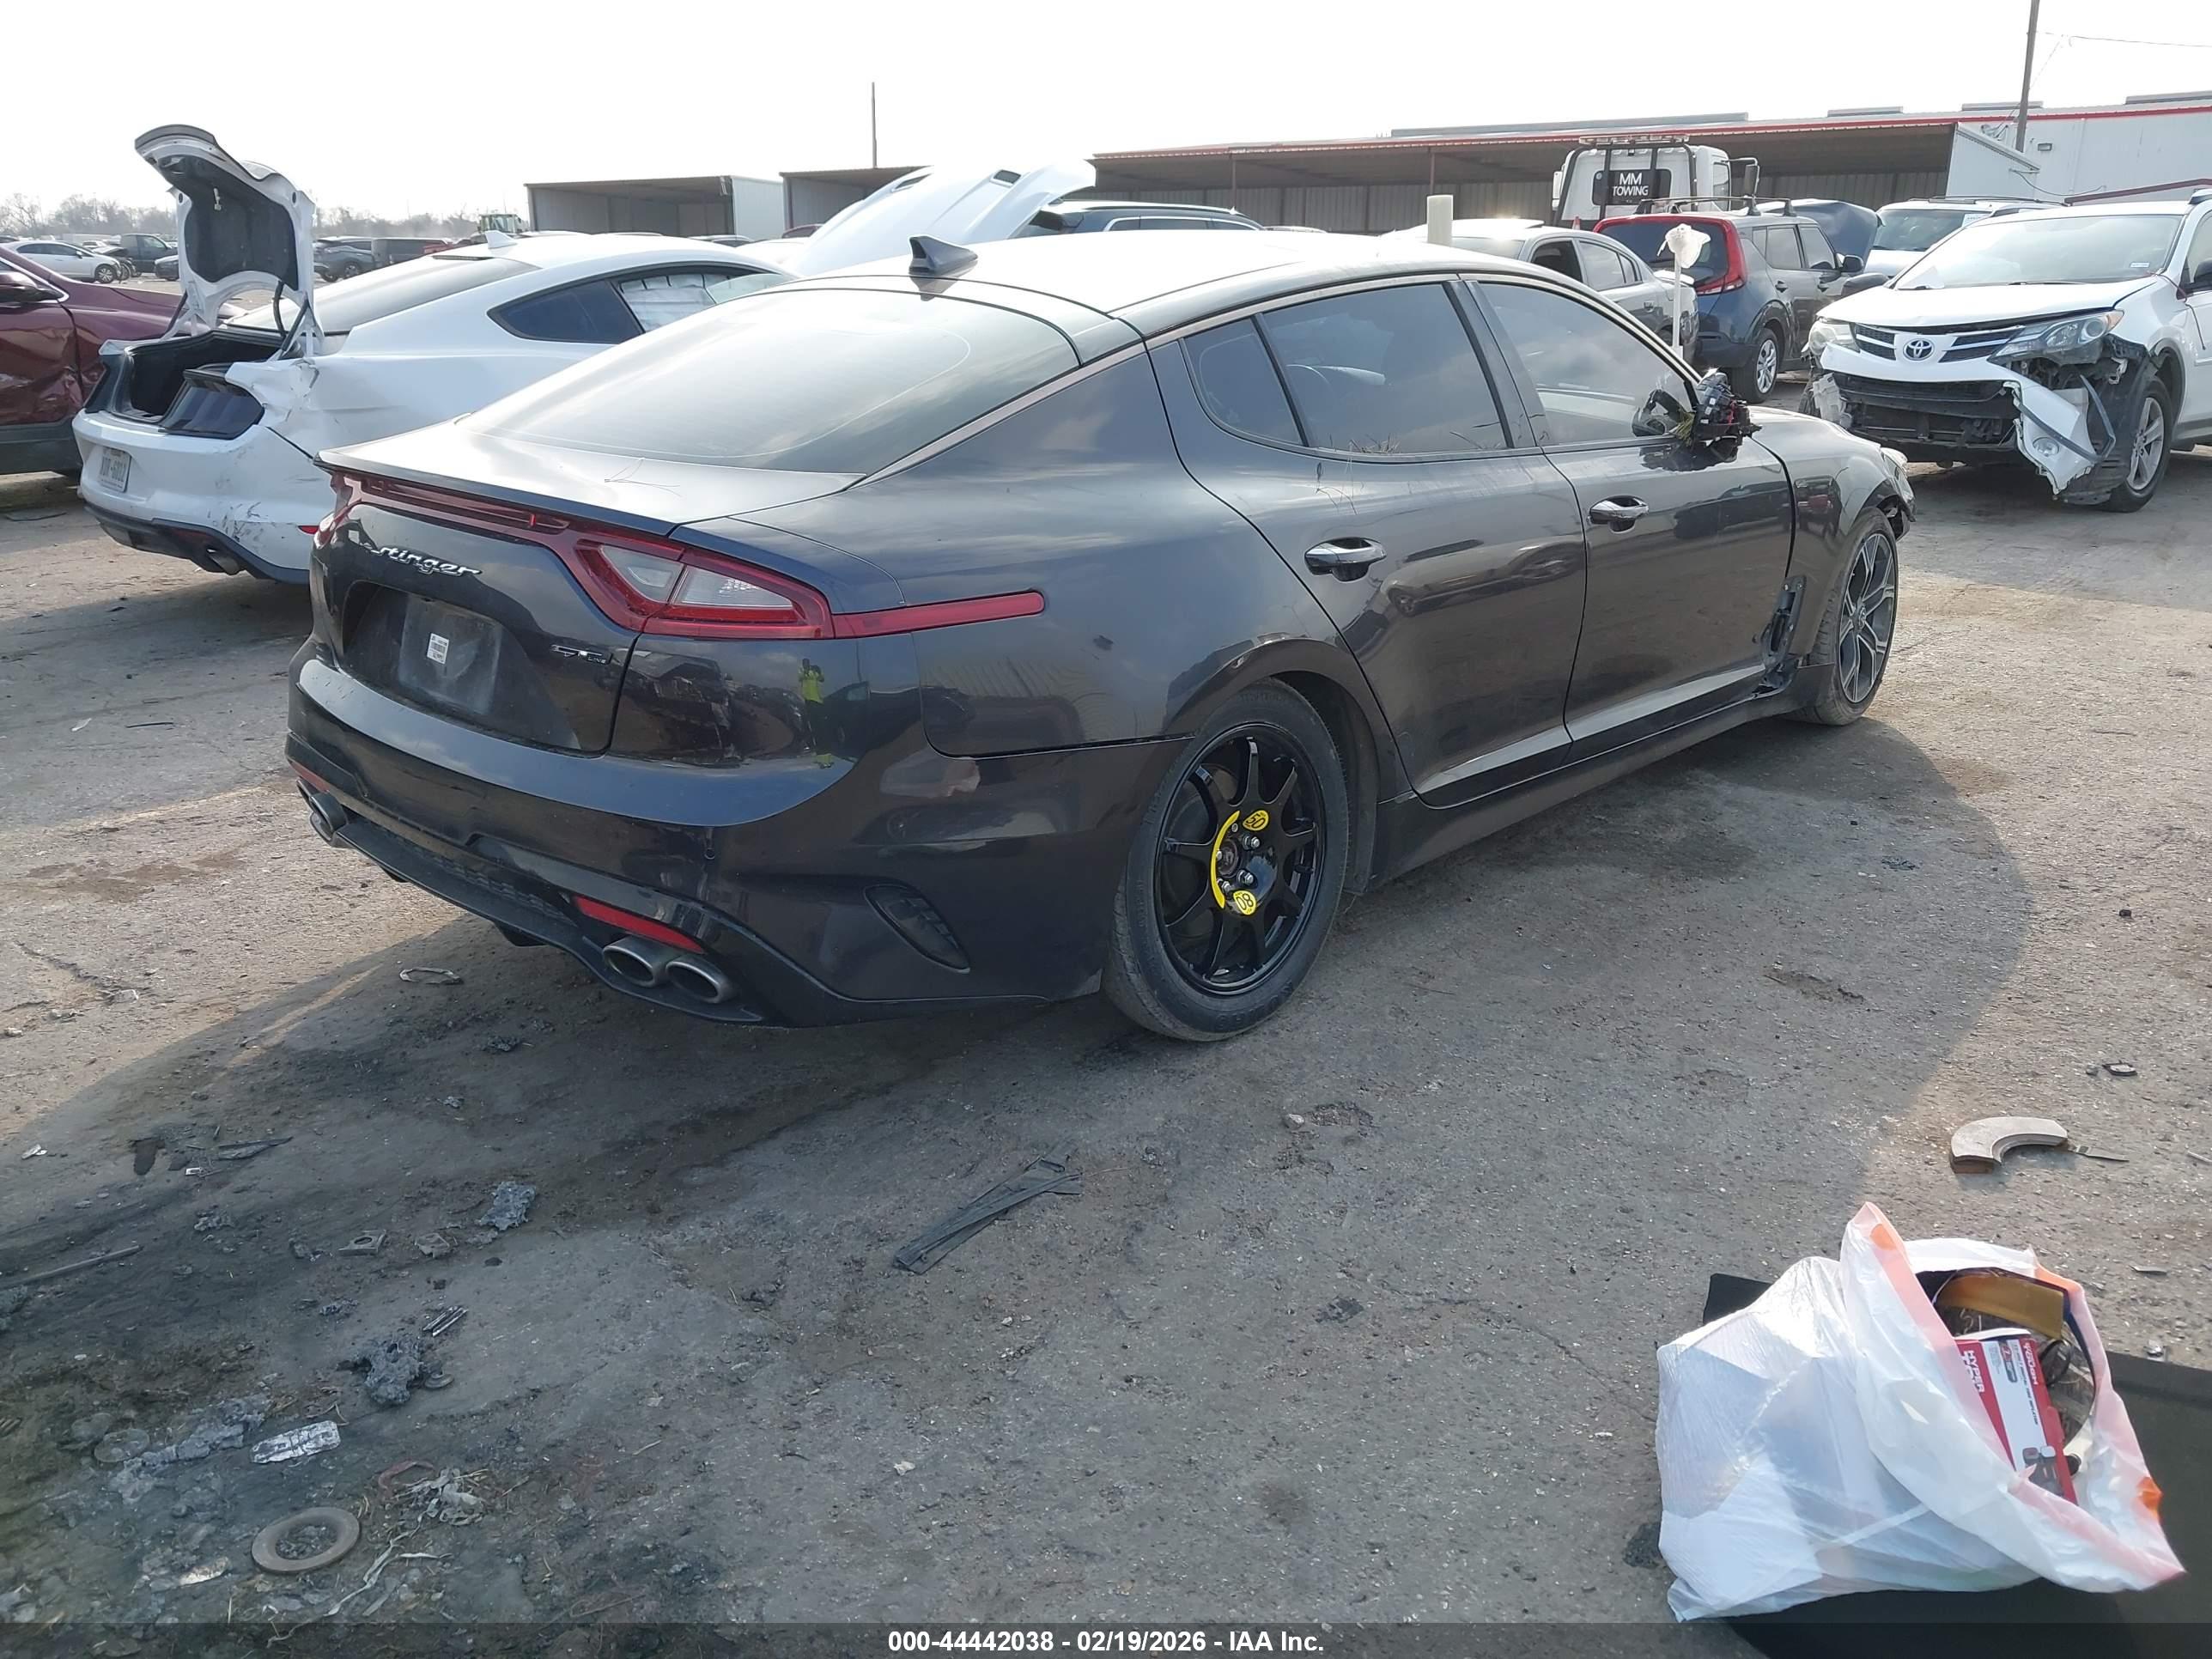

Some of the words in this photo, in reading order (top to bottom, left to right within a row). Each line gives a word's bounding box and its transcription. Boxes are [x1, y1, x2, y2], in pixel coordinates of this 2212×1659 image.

[1620, 173, 1642, 185] MM
[1613, 185, 1649, 196] TOWING
[1245, 813, 1266, 829] 50
[1964, 1350, 1985, 1393] HYPER
